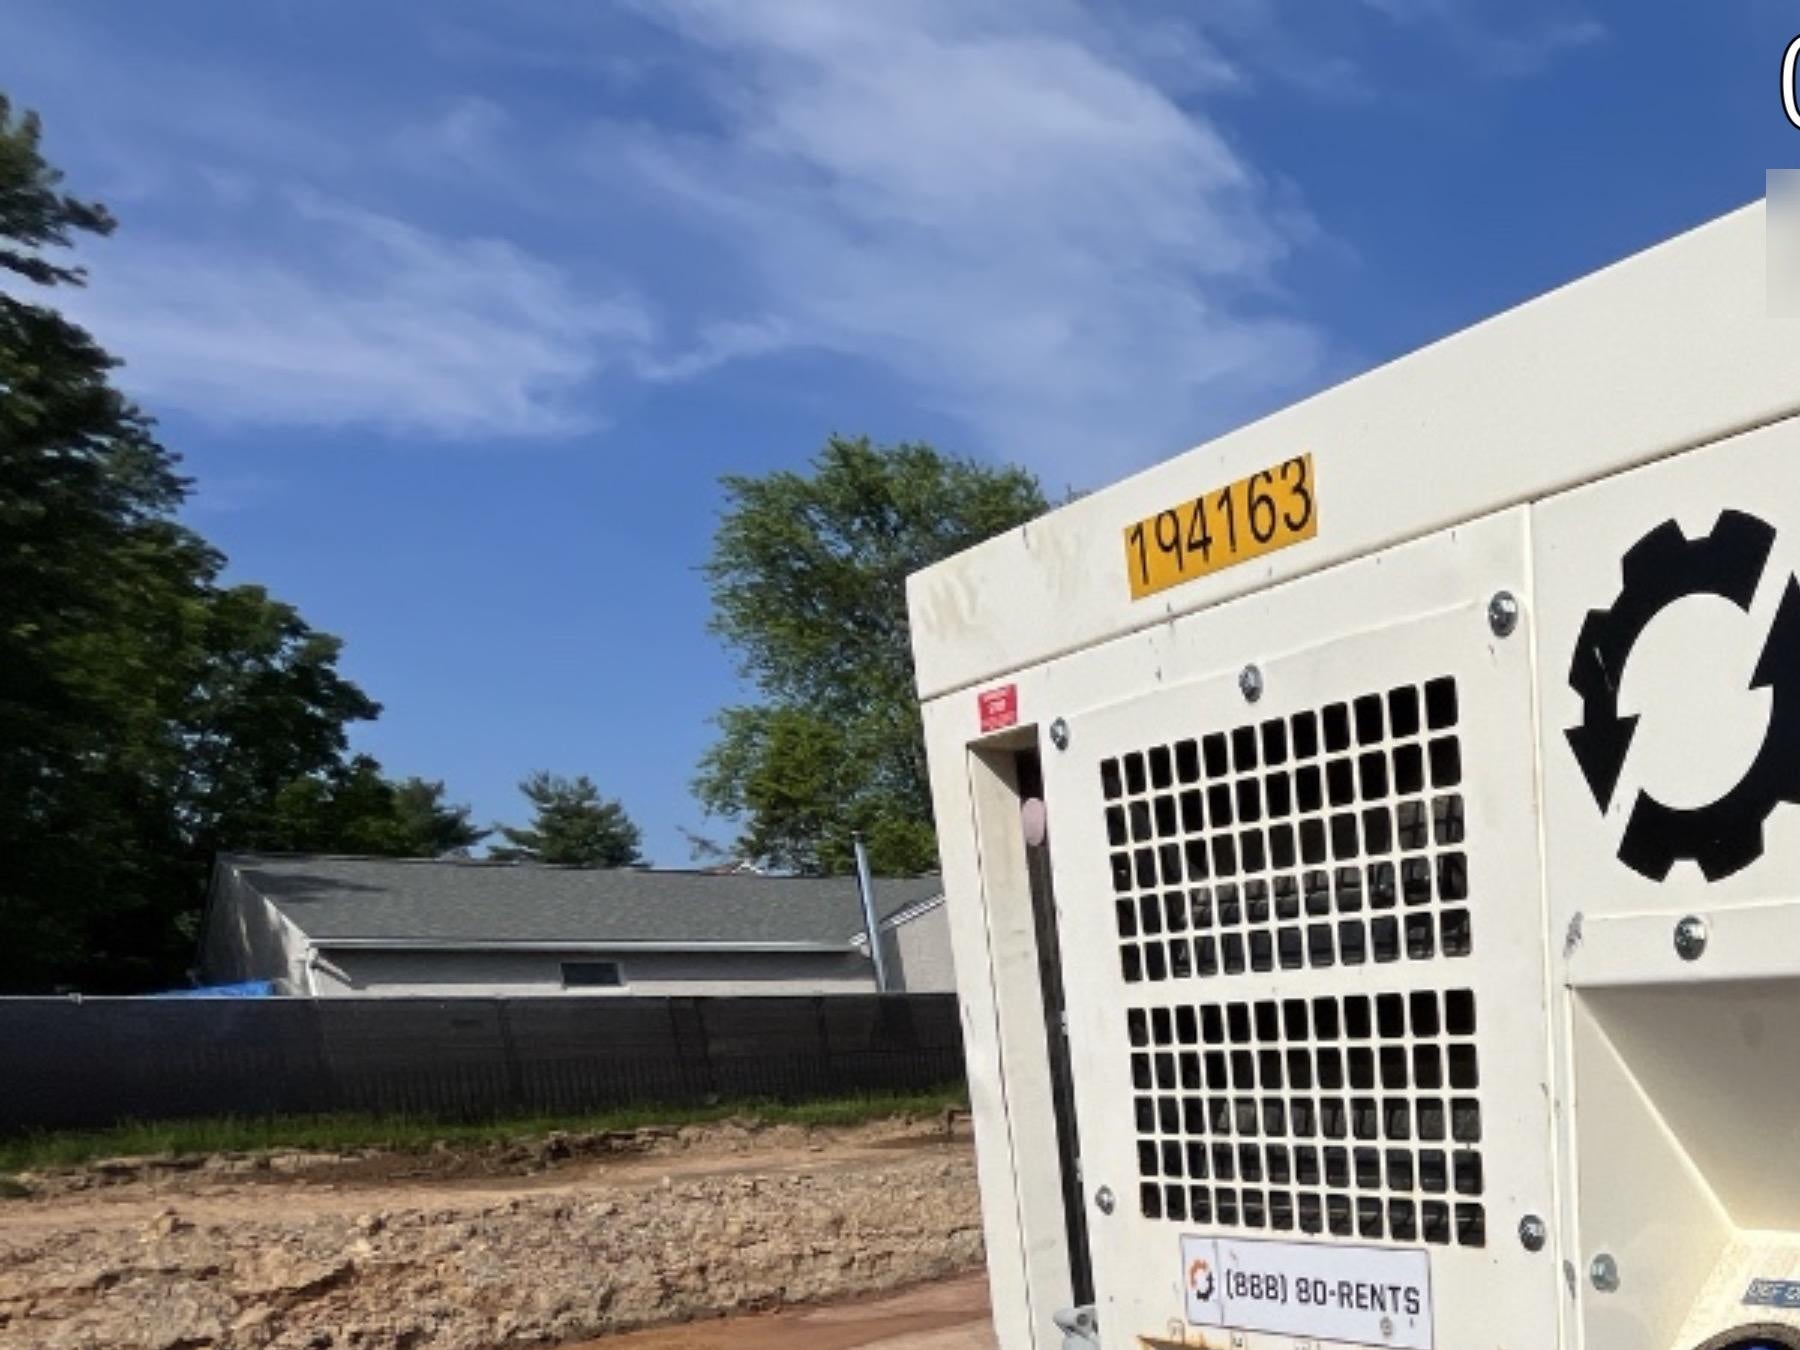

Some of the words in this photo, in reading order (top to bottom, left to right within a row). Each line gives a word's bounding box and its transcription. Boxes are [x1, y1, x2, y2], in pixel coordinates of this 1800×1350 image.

[1130, 455, 1312, 586] 194163
[1225, 1268, 1288, 1304] (888)
[1295, 1276, 1420, 1315] 80-RENTS
